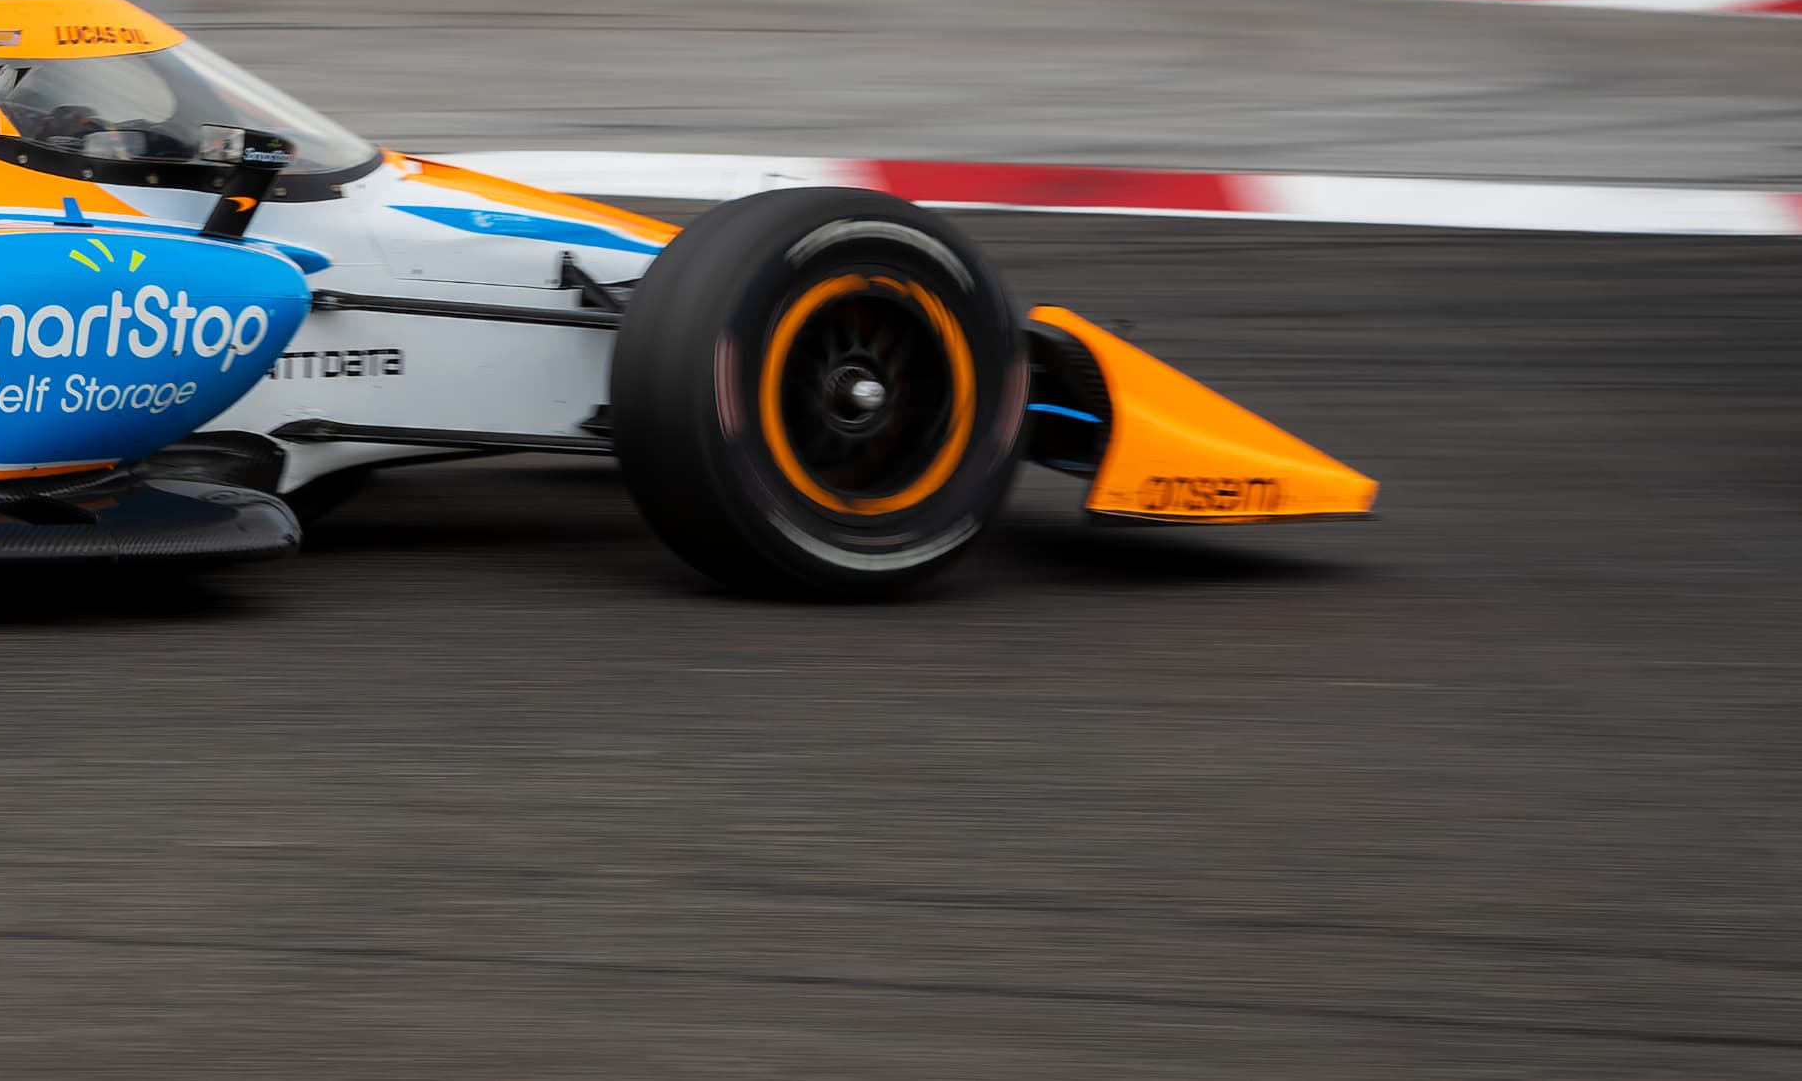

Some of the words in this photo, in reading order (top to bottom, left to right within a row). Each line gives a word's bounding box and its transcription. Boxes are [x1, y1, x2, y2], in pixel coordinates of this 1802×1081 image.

[54, 25, 116, 45] LUCAS
[119, 27, 151, 45] OIL
[60, 373, 198, 414] Storage
